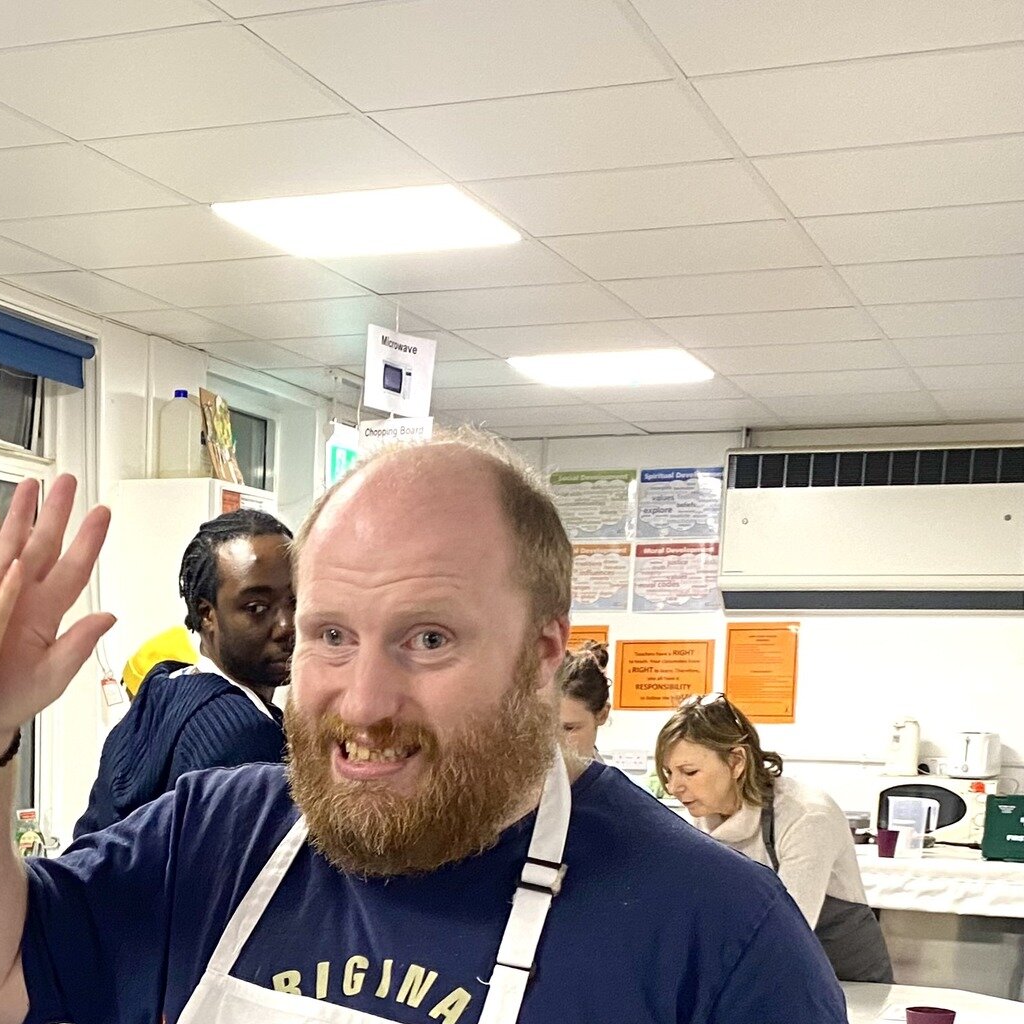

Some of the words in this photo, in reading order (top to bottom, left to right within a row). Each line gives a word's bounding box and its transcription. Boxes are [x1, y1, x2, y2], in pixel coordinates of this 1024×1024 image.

[381, 335, 418, 355] Microwave
[365, 427, 397, 438] Chopping
[400, 425, 424, 436] Board
